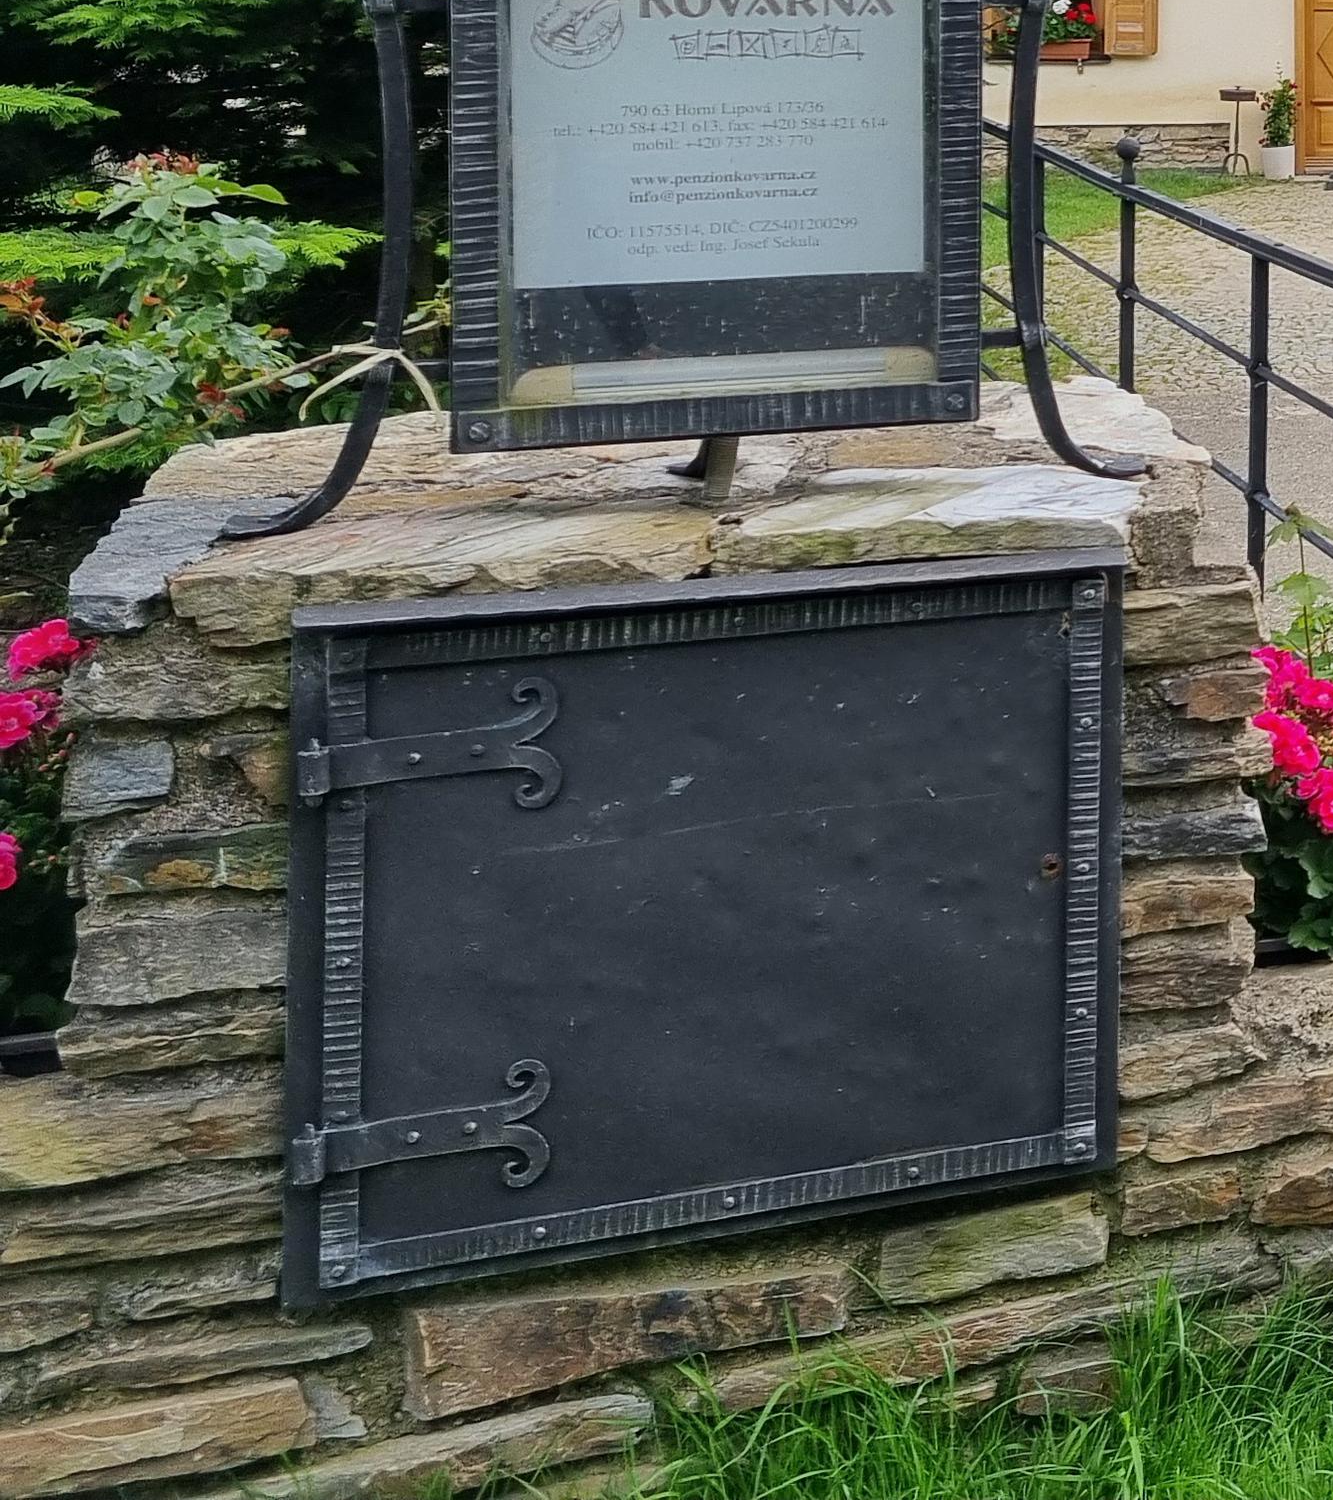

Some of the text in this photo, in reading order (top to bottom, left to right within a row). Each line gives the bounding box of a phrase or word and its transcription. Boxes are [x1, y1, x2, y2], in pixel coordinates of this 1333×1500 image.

[621, 104, 648, 117] 790
[652, 103, 670, 117] 63
[721, 102, 771, 117] Lipová
[588, 122, 624, 136] +420
[660, 120, 686, 134] 421
[760, 118, 796, 131] +420
[630, 170, 817, 187] www.penzionkovarna.cz
[629, 186, 818, 204] info@penzionkovarna.cz
[733, 237, 769, 251] Josef
